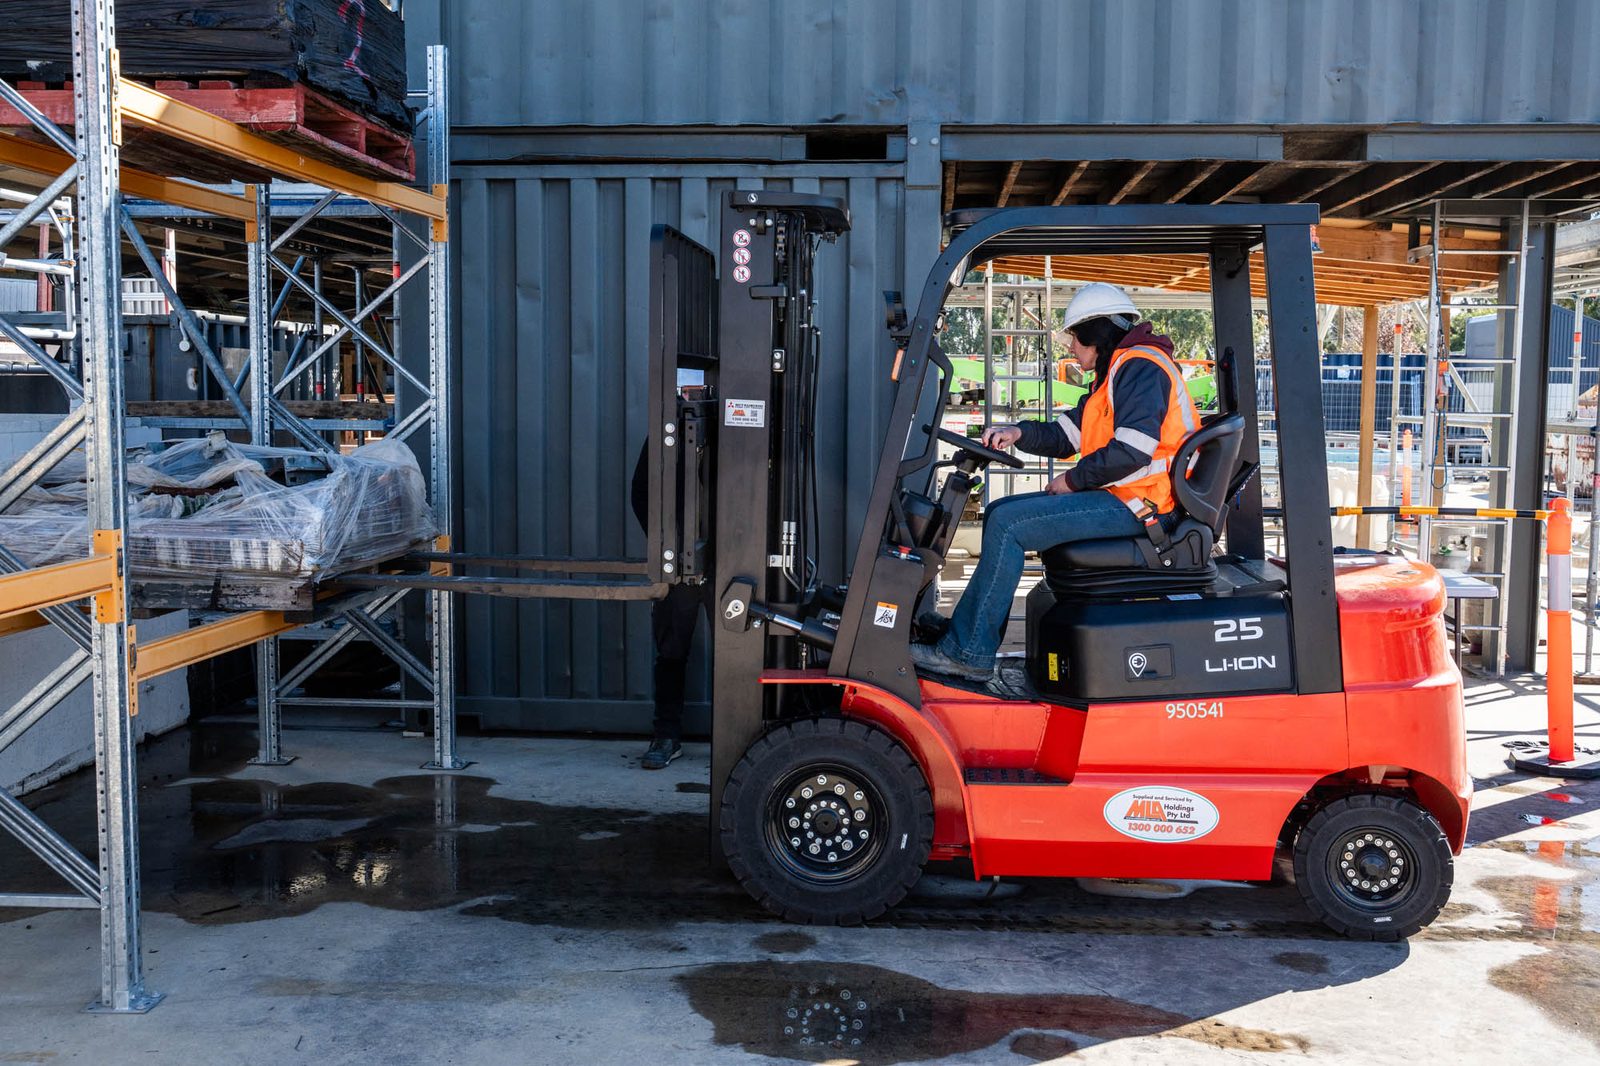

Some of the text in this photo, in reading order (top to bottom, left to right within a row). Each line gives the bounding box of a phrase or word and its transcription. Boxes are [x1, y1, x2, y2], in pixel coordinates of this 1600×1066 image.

[1213, 617, 1264, 643] 25
[1165, 702, 1224, 719] 950541
[1163, 804, 1194, 812] Holdings
[1166, 811, 1178, 819] Pty
[1127, 822, 1196, 835] 1300 000 652
